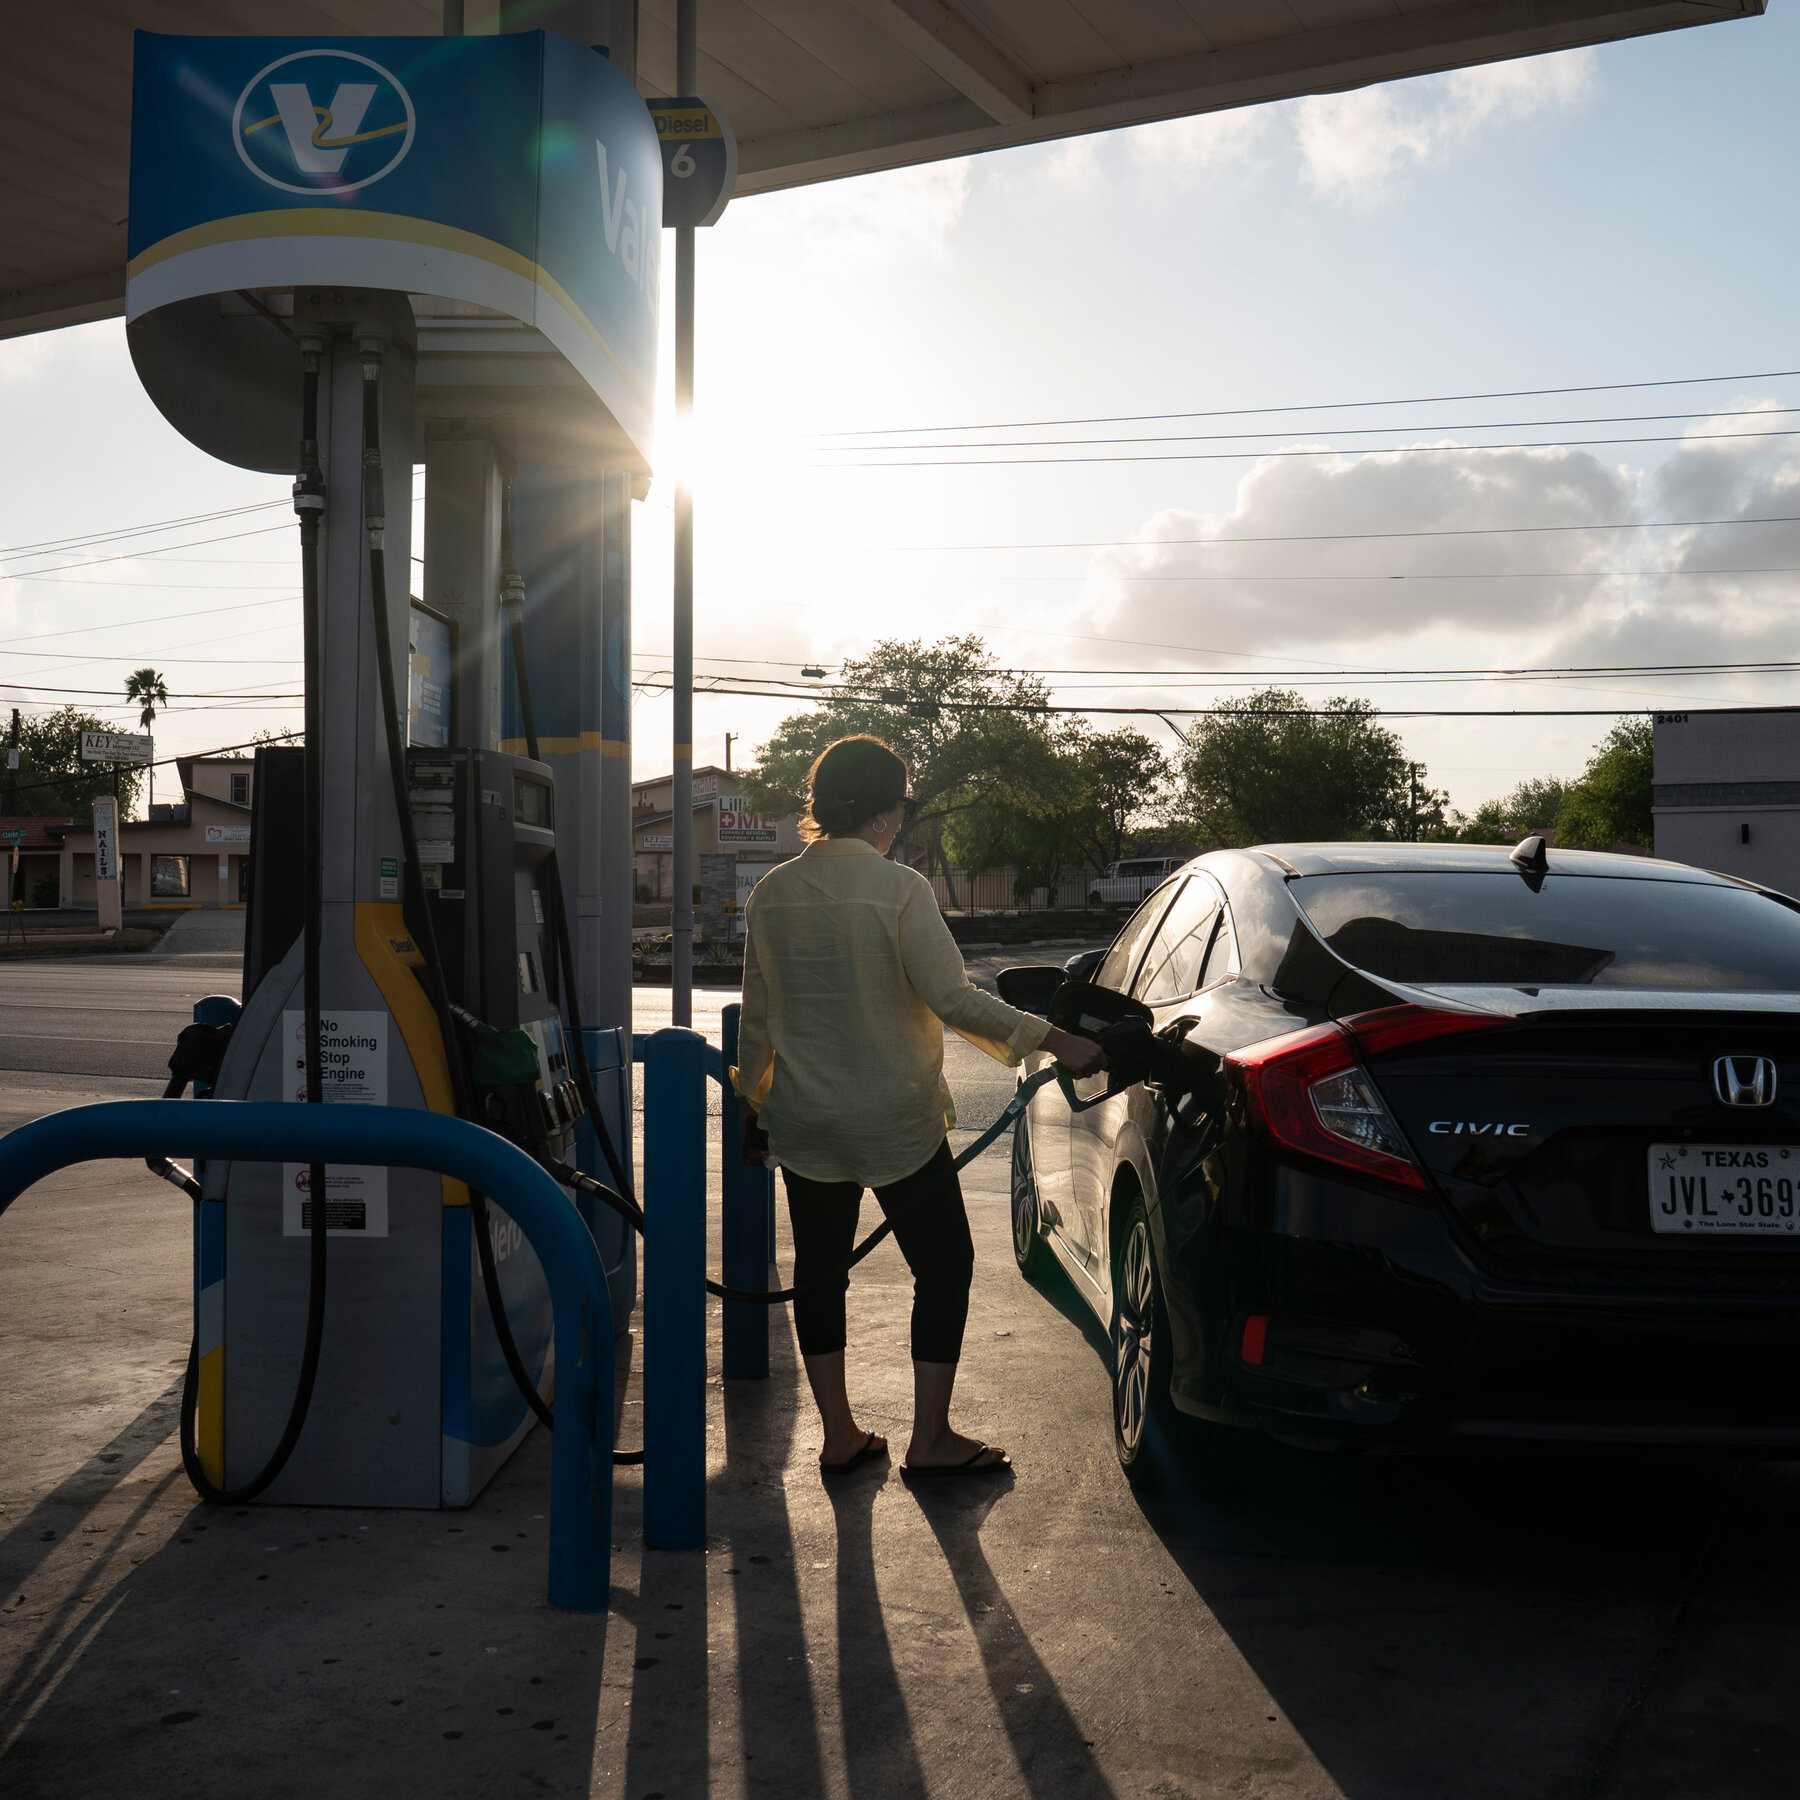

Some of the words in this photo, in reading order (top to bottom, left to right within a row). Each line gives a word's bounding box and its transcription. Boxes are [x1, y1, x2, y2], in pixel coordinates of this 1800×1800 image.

[655, 114, 708, 134] Diesel
[670, 144, 696, 178] 6
[595, 137, 660, 322] Vale
[1656, 714, 1688, 725] 2401
[85, 734, 113, 749] KEY
[719, 811, 777, 829] DME
[97, 830, 108, 875] NAILS
[320, 1019, 338, 1032] No
[320, 1035, 377, 1051] Smoking
[320, 1051, 350, 1066] Stop
[320, 1067, 365, 1083] Engine
[1428, 1120, 1530, 1136] CIVIC
[1701, 1151, 1769, 1168] TEXAS
[1736, 1178, 1800, 1217] 369
[1699, 1220, 1714, 1228] The
[1757, 1221, 1780, 1229] State
